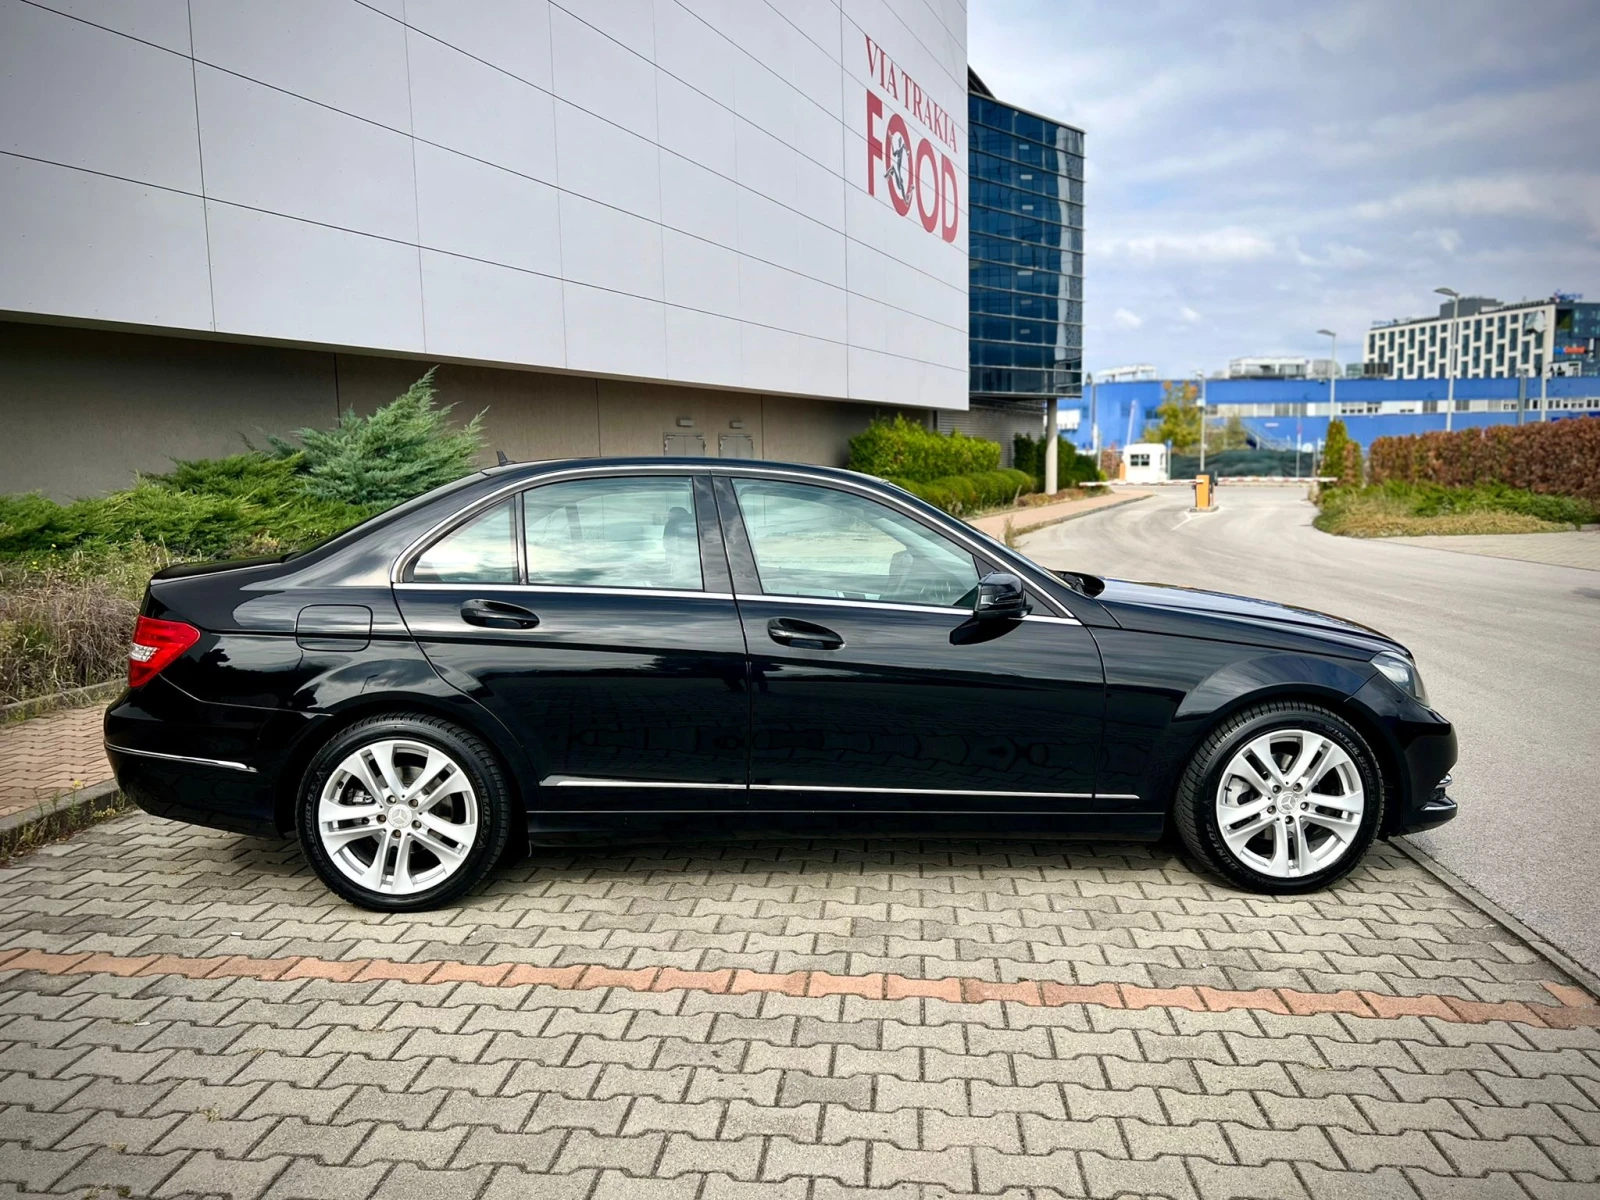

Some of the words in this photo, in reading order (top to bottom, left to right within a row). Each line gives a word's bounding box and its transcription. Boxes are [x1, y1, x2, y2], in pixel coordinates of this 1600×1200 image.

[865, 33, 899, 101] VIA
[901, 69, 958, 154] TRAKIA
[866, 88, 959, 244] FOOD
[1324, 724, 1361, 756] WINTER
[1358, 756, 1377, 794] SPORT
[304, 804, 316, 845] SPORT
[1204, 823, 1240, 872] DUNLOP
